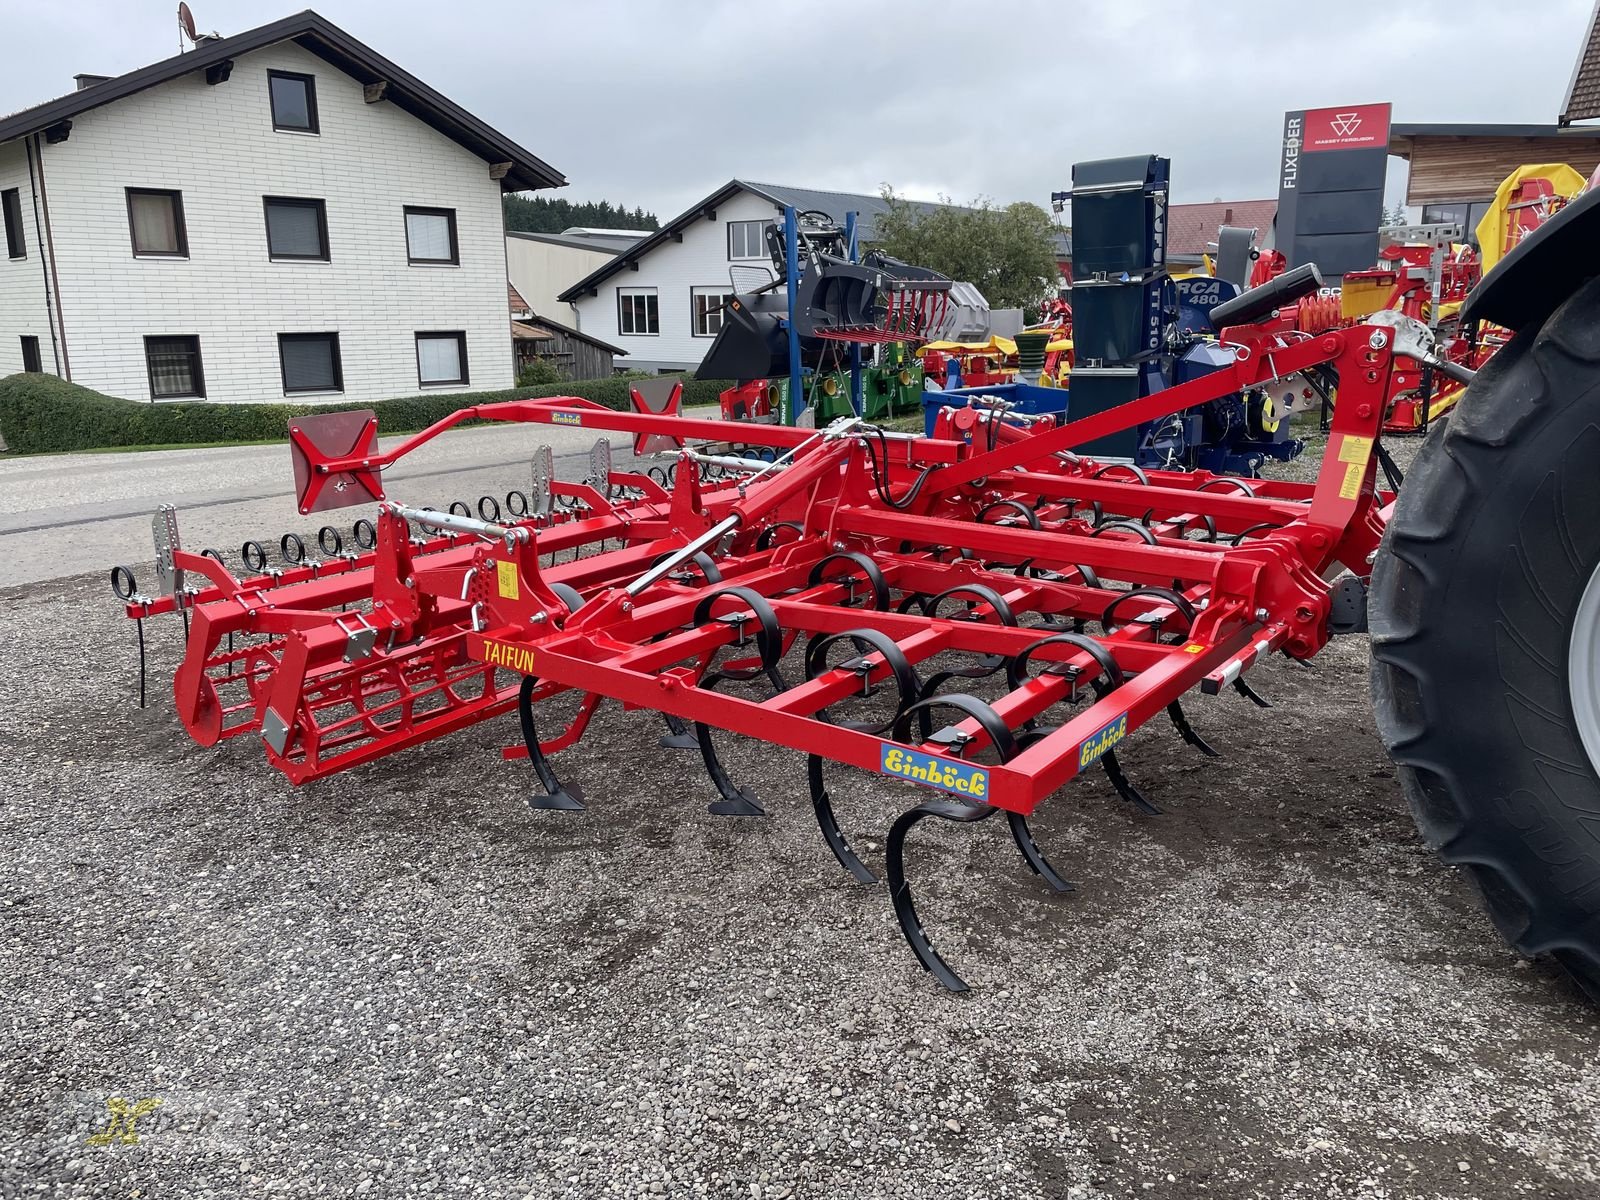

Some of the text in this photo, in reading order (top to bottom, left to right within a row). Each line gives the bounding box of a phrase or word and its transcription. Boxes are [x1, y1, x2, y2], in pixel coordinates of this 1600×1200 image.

[1283, 118, 1301, 189] FLIXEDER
[1151, 288, 1161, 311] TT
[1188, 294, 1219, 305] 480
[1149, 316, 1160, 349] 510
[483, 640, 535, 673] TAIFUN
[1080, 718, 1127, 768] Einböck
[884, 748, 986, 797] Einböck
